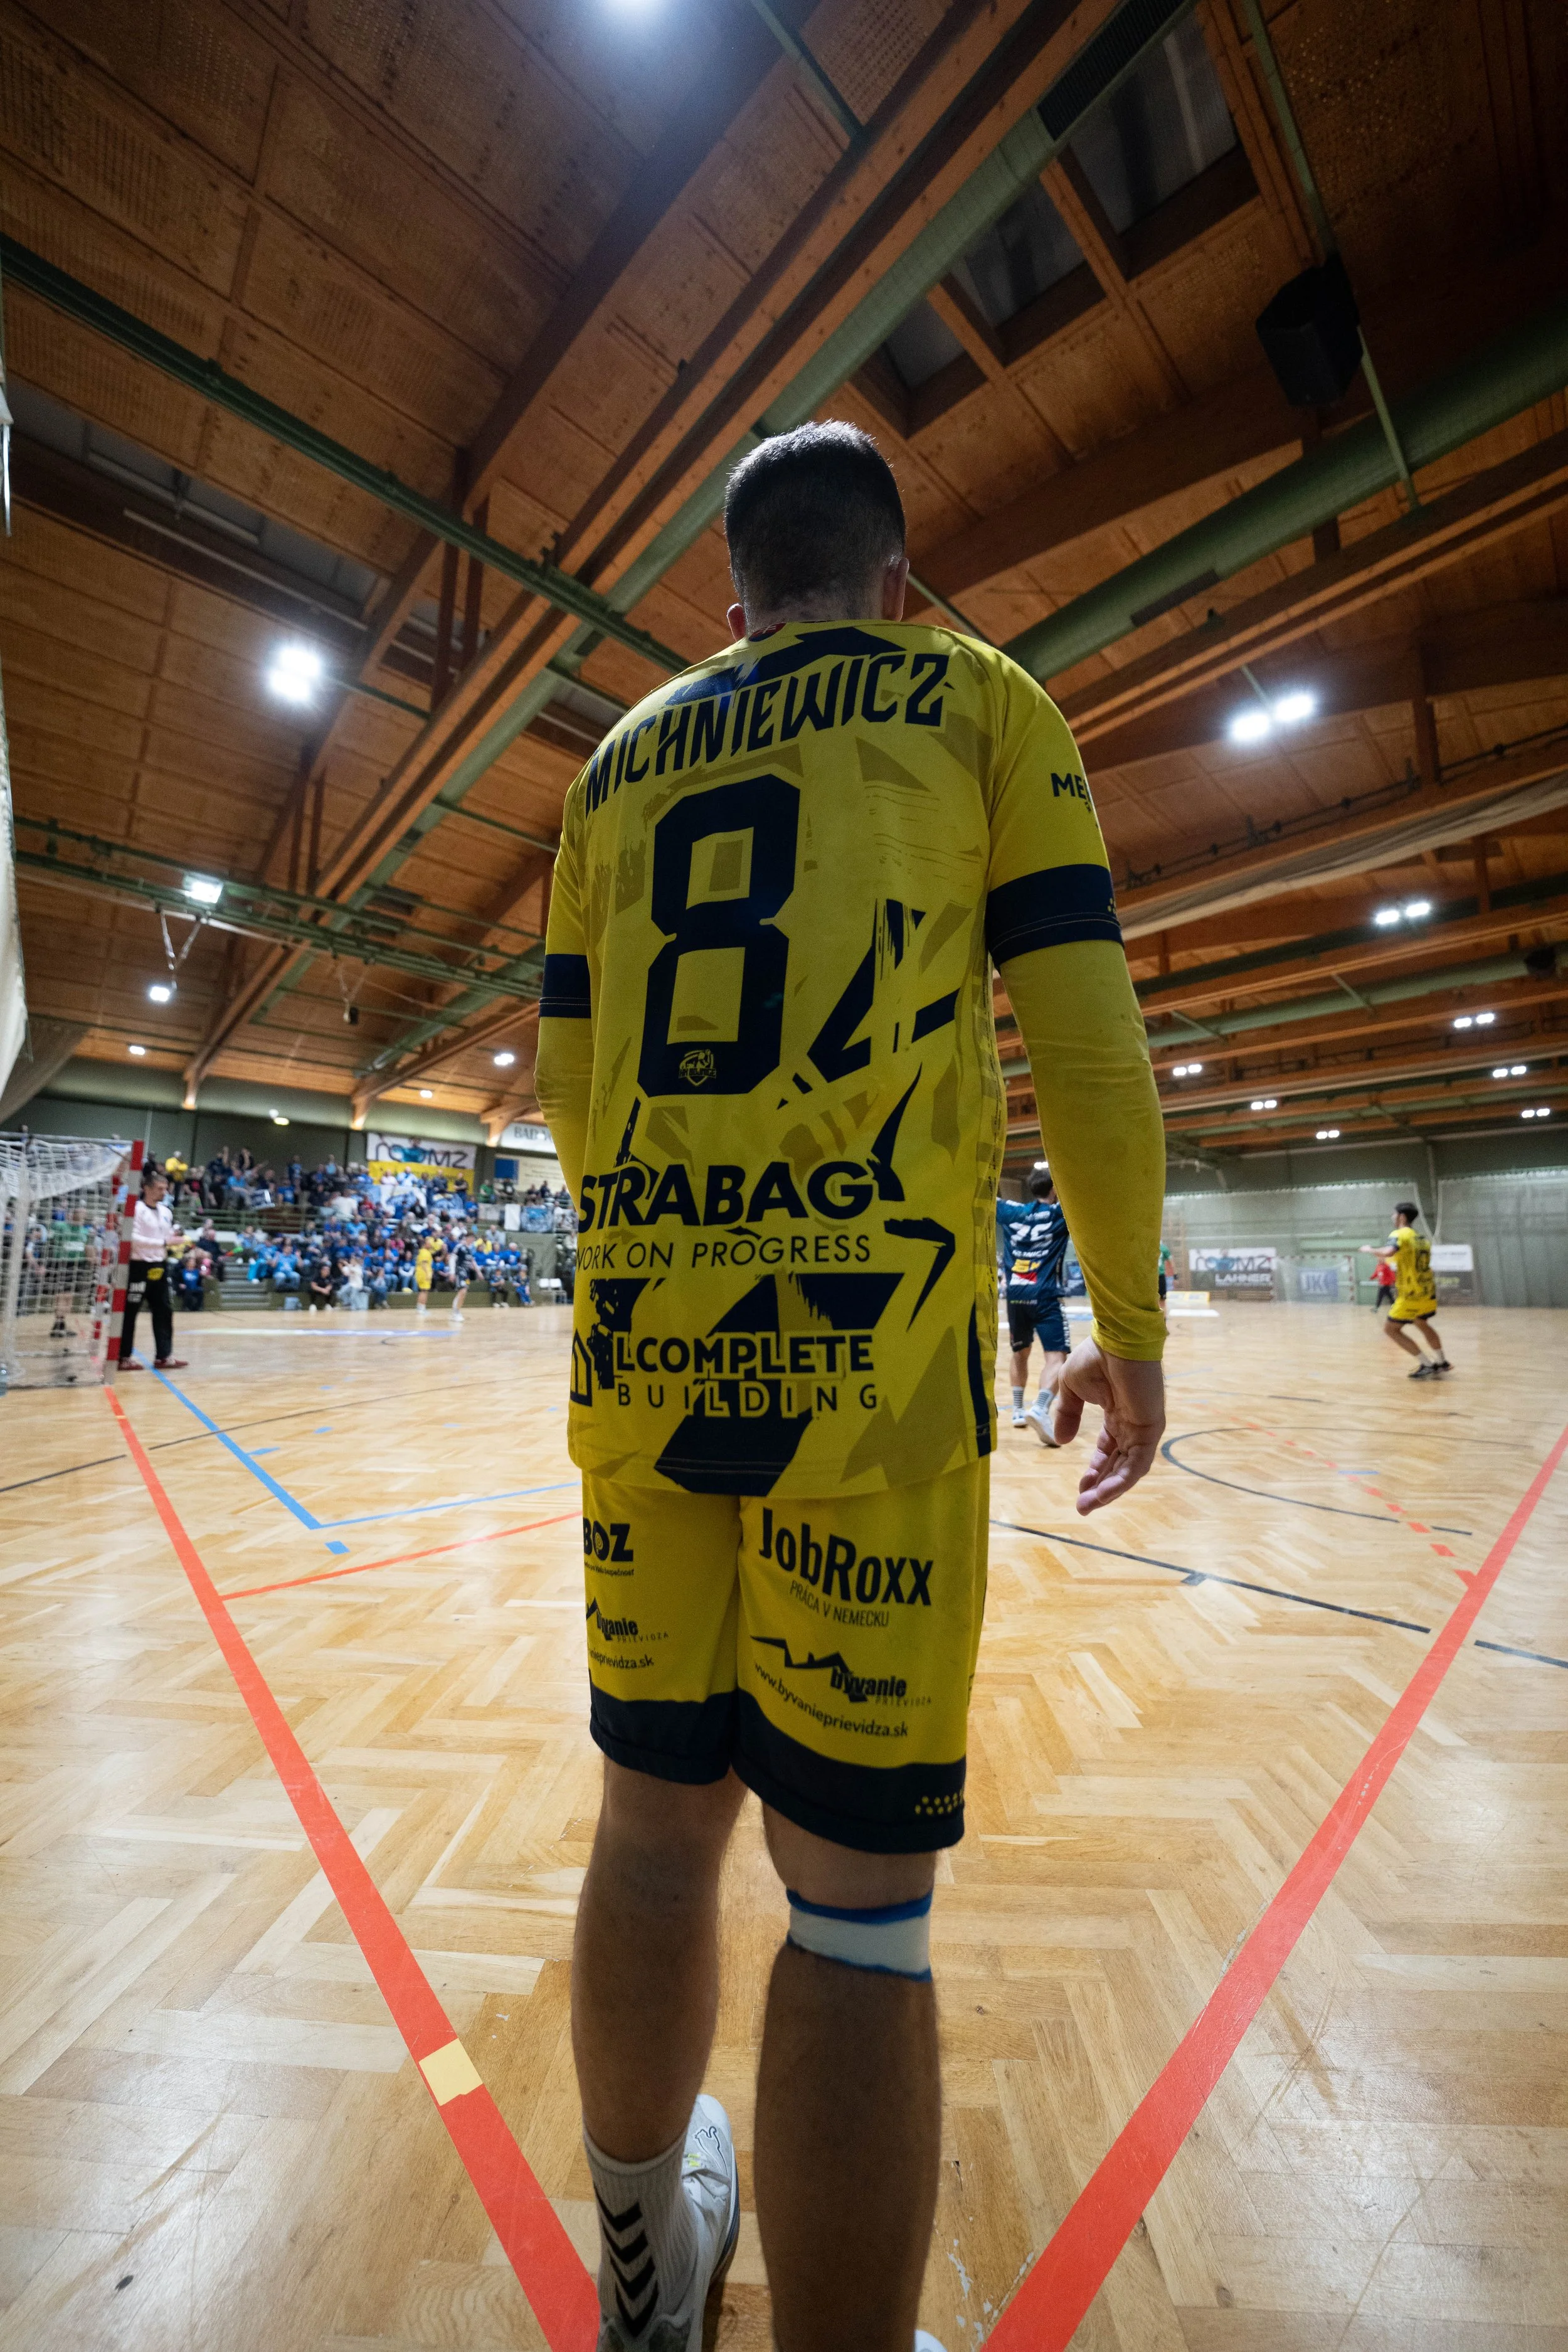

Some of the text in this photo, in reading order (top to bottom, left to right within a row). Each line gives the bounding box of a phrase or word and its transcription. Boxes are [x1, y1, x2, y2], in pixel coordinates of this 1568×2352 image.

[585, 653, 949, 820] MICHNIEWICZ
[637, 773, 801, 1097] 8
[578, 1161, 874, 1233] STRABAG
[627, 1241, 674, 1268] ON
[691, 1234, 871, 1268] PROGRESS
[618, 1383, 877, 1412] BUILDING
[759, 1507, 933, 1606] JobRoxx
[823, 1602, 832, 1618] V
